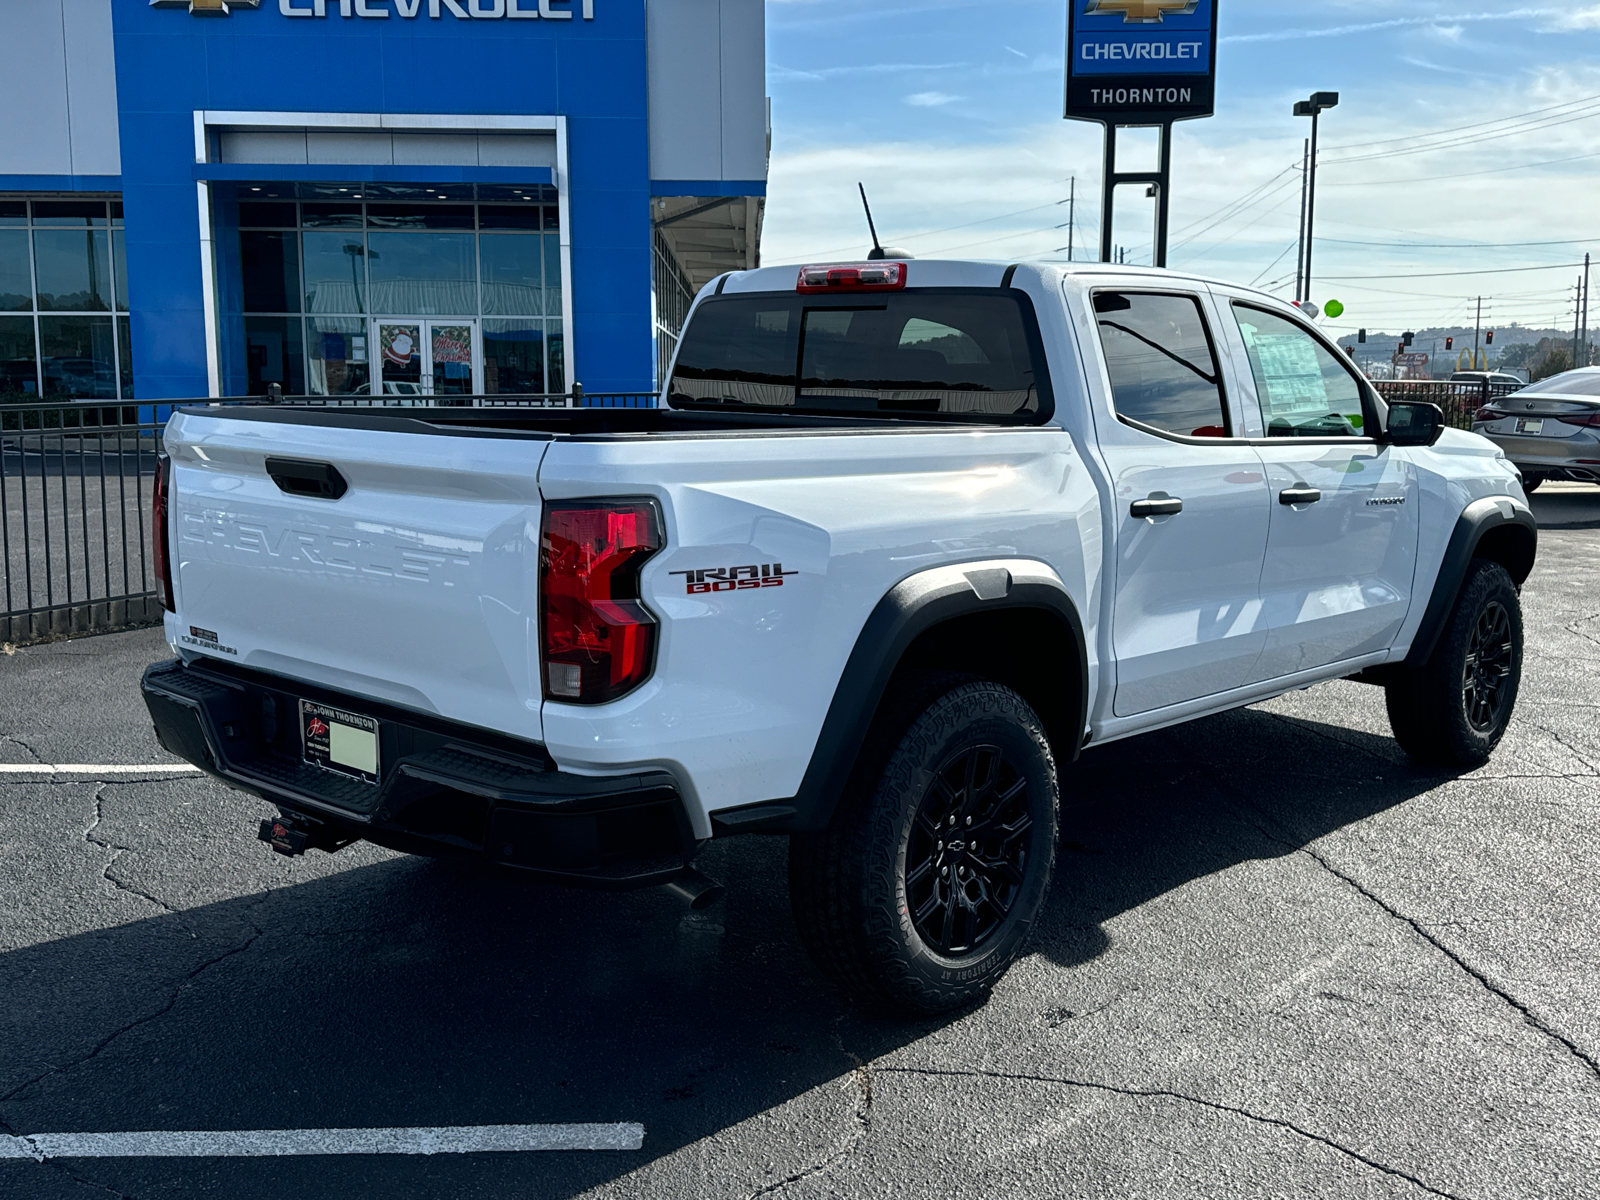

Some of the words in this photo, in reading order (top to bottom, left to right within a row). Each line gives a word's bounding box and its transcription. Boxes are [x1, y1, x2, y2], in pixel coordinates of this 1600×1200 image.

[1082, 42, 1202, 60] CHEVROLET
[1090, 87, 1191, 103] THORNTON
[183, 511, 470, 586] CHEVROLET
[668, 562, 799, 583] TRAIL
[686, 576, 784, 594] BOSS
[317, 706, 335, 718] JOHN
[335, 710, 373, 729] THORNTON
[940, 970, 952, 980] AT
[956, 951, 1001, 981] TERRITORY
